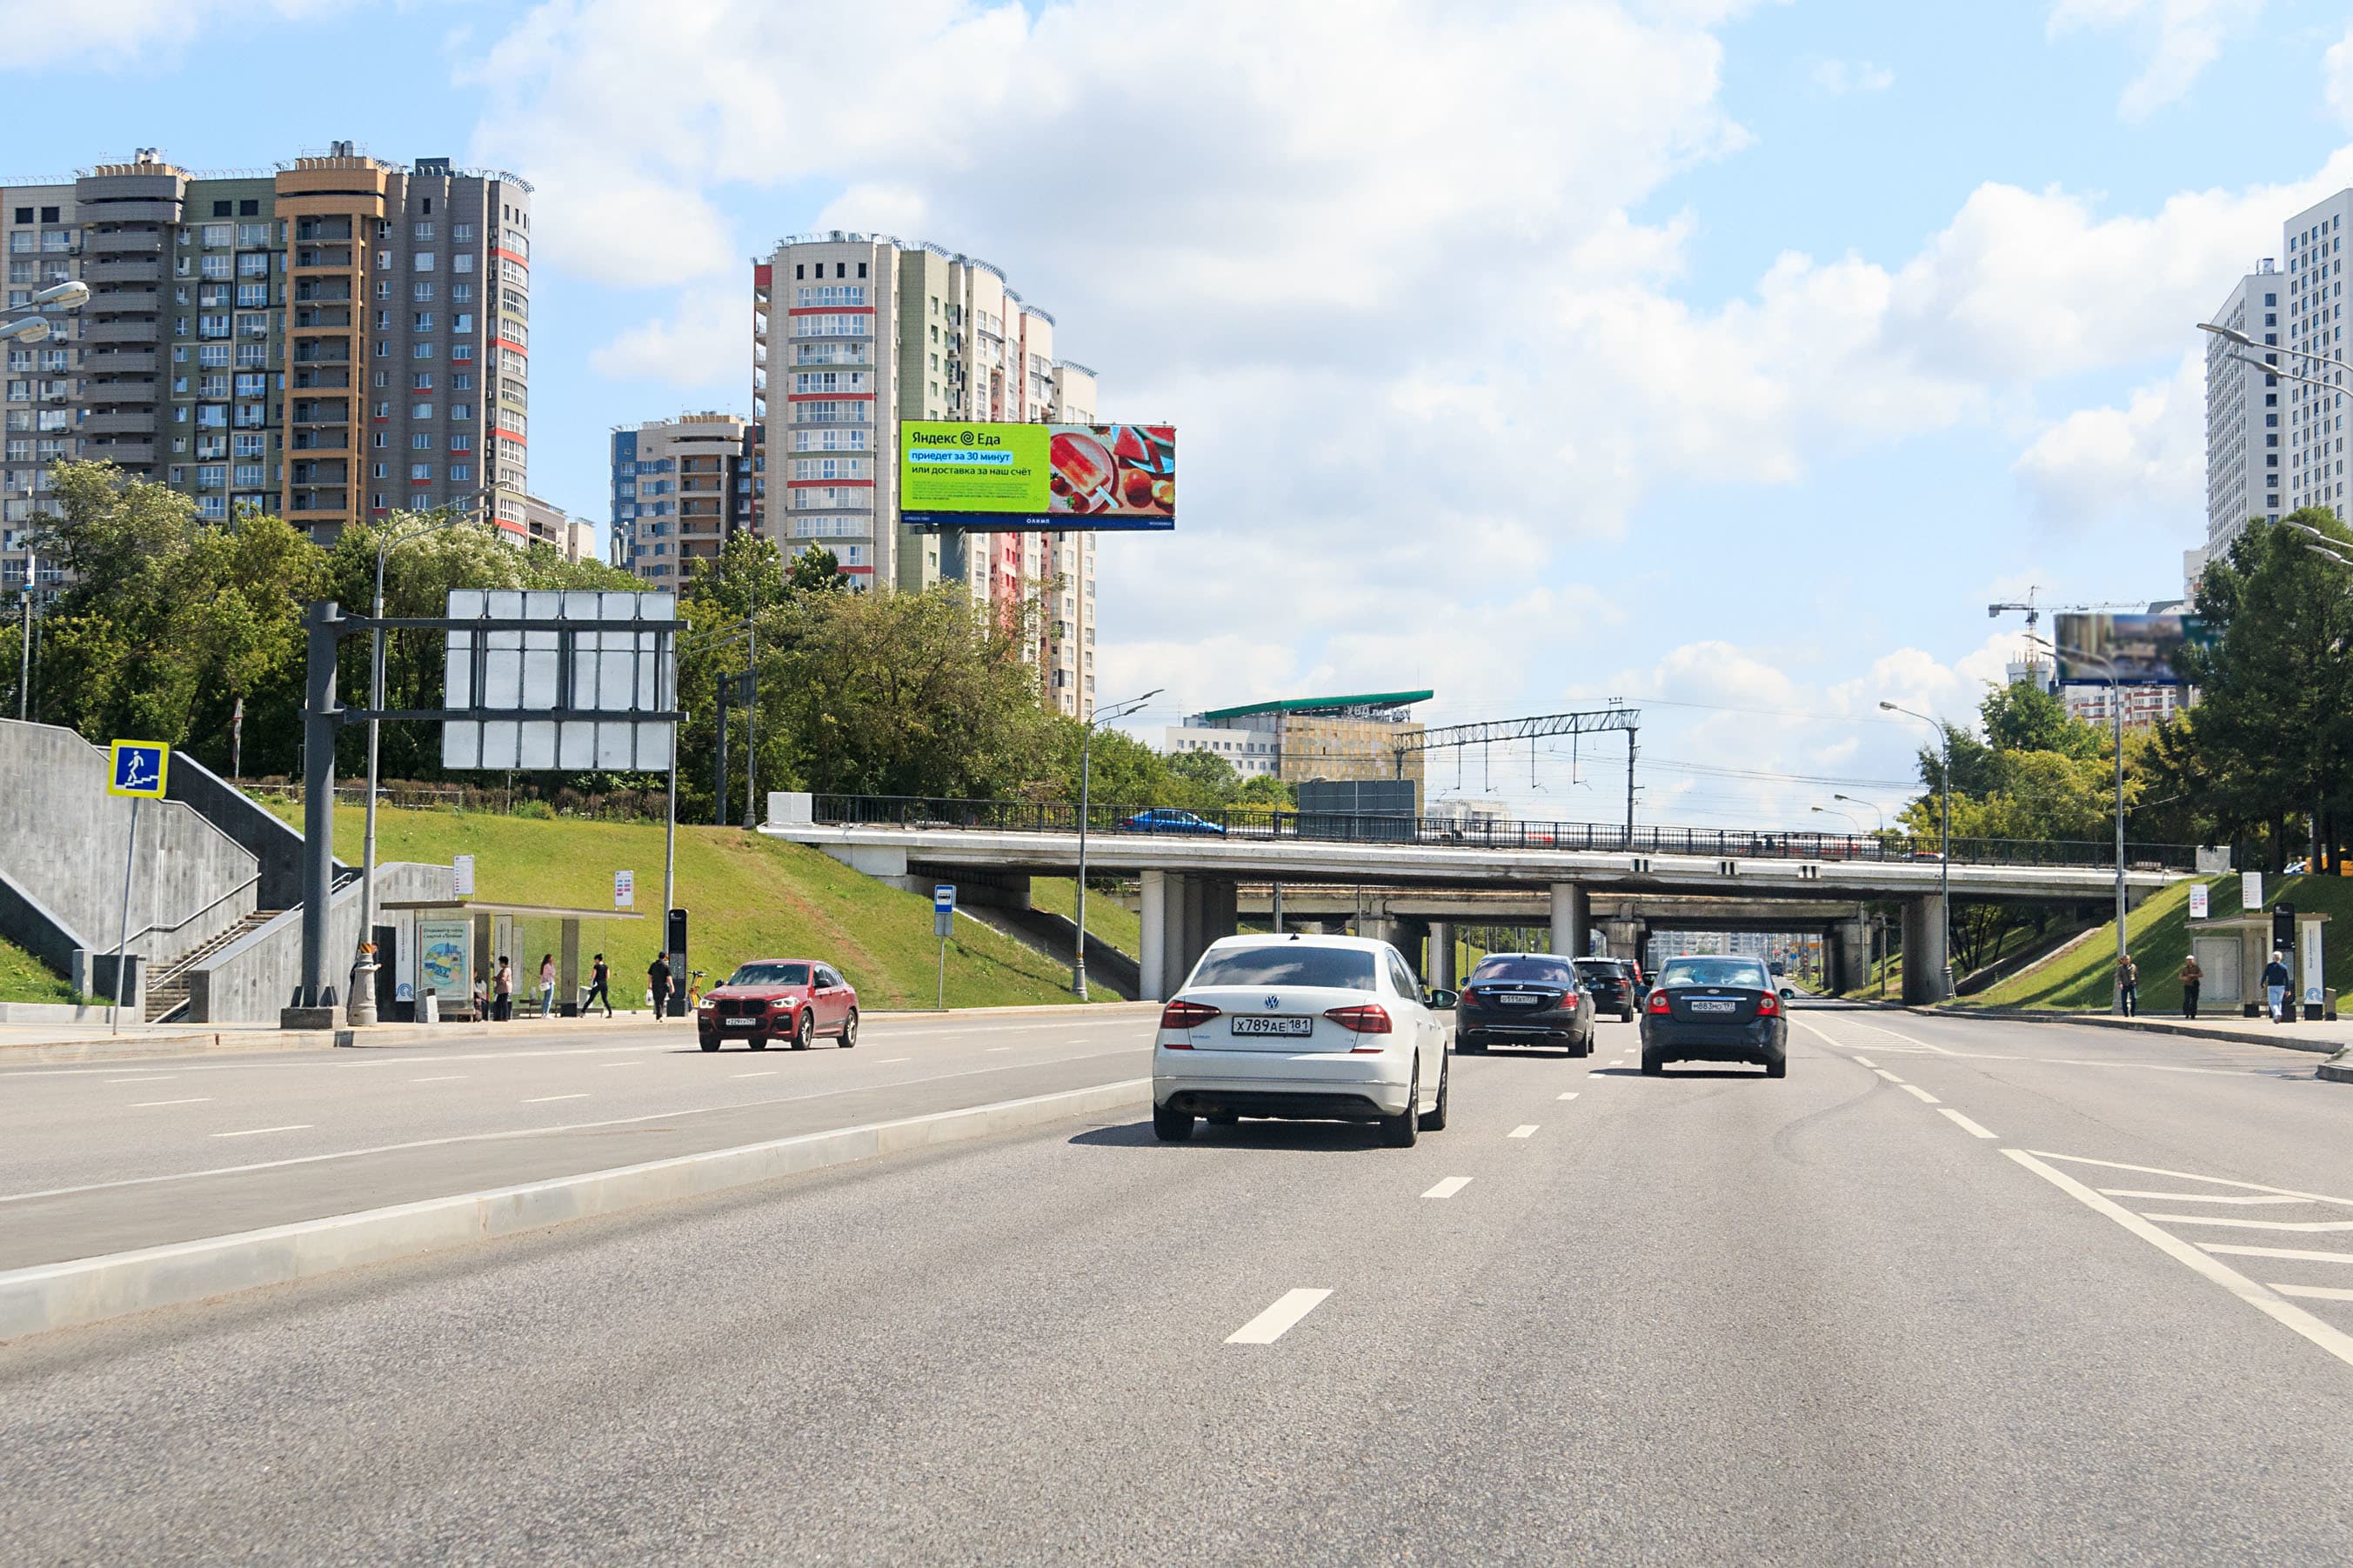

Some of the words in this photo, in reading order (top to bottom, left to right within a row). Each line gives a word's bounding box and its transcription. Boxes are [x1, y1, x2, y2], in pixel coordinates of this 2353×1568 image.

[912, 431, 958, 444] Яндекс
[978, 433, 1000, 446] Еда
[912, 452, 953, 461] приедет
[966, 452, 979, 461] 30
[980, 454, 1010, 463] минут
[1011, 467, 1032, 476] счёт
